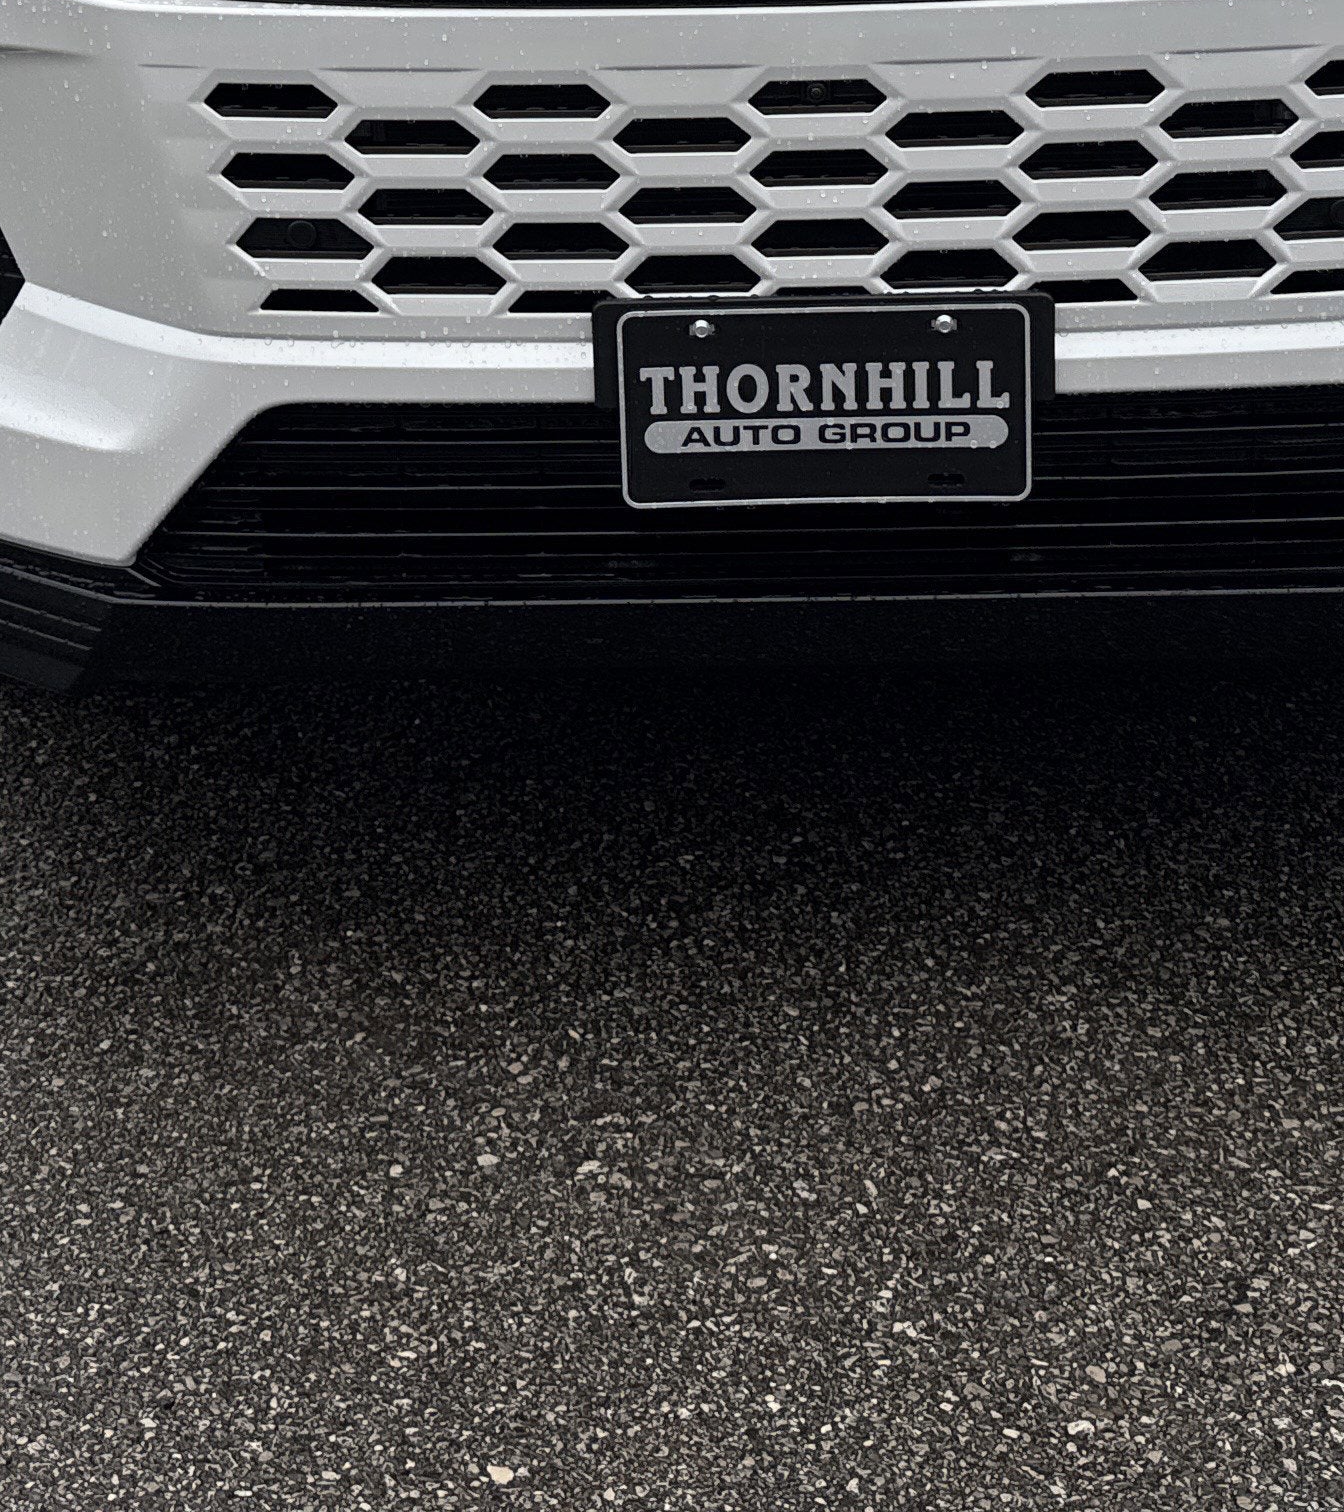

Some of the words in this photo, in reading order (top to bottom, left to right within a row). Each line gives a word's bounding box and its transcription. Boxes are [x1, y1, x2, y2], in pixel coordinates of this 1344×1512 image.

[639, 360, 1011, 414] THORNHILL
[681, 424, 801, 448] AUTO
[818, 421, 972, 445] GROUP
